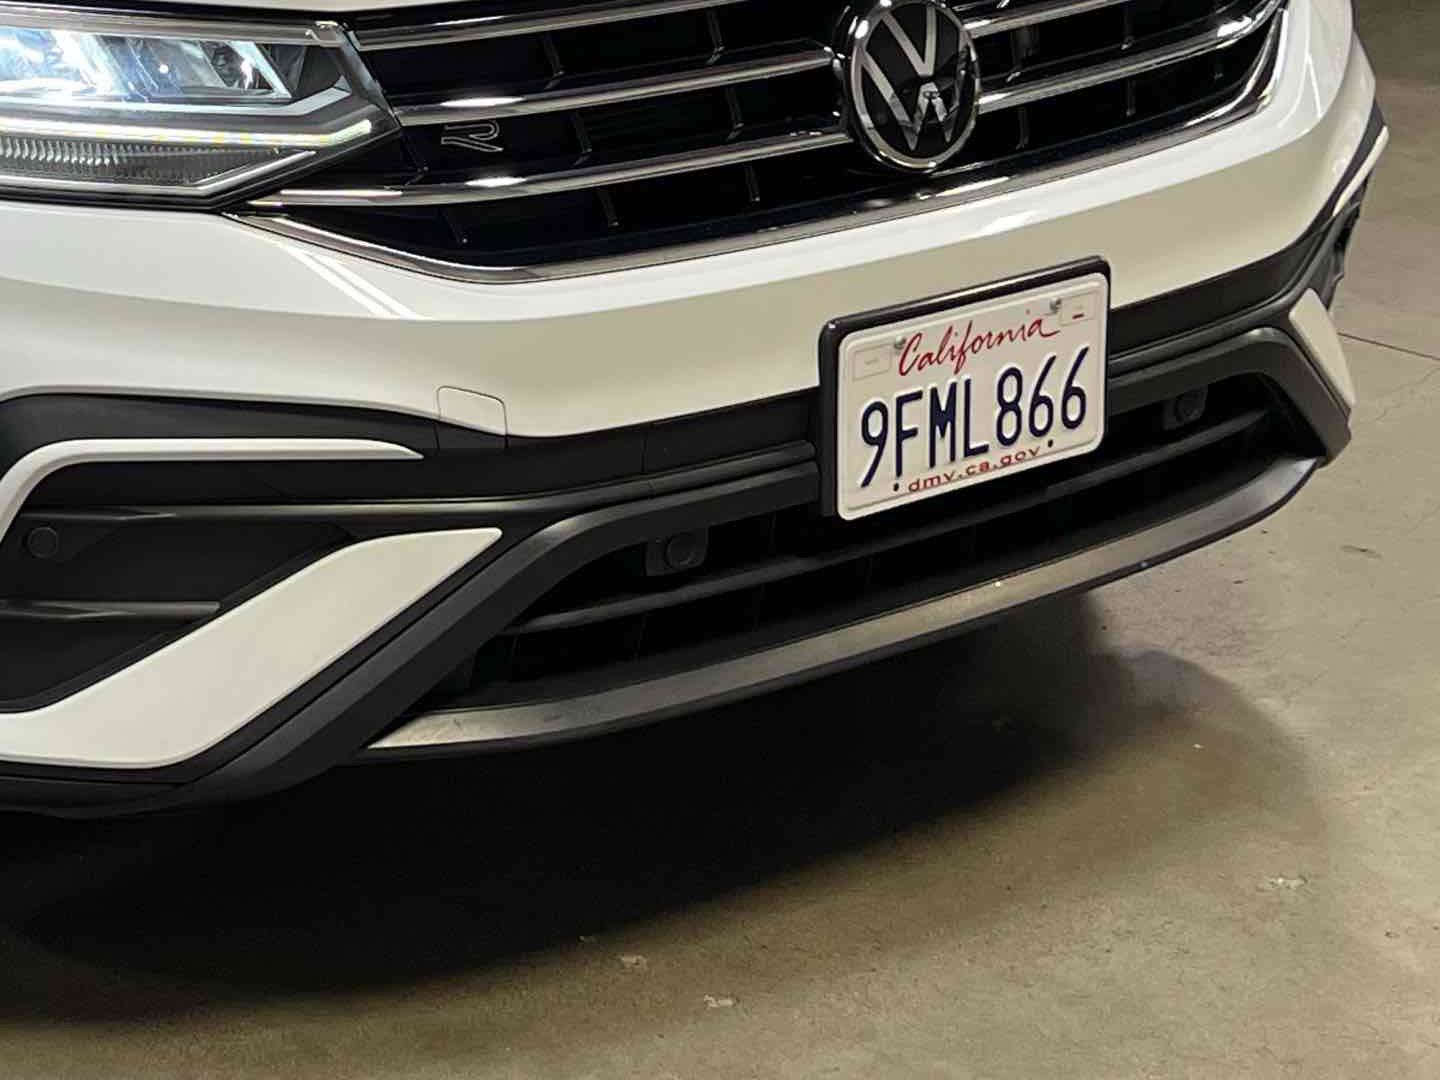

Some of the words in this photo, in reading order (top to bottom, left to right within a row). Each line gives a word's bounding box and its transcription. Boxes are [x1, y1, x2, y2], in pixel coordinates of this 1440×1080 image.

[898, 308, 1060, 376] California
[860, 346, 1090, 488] 9FML866
[907, 446, 1041, 493] dmv.ca.gov
